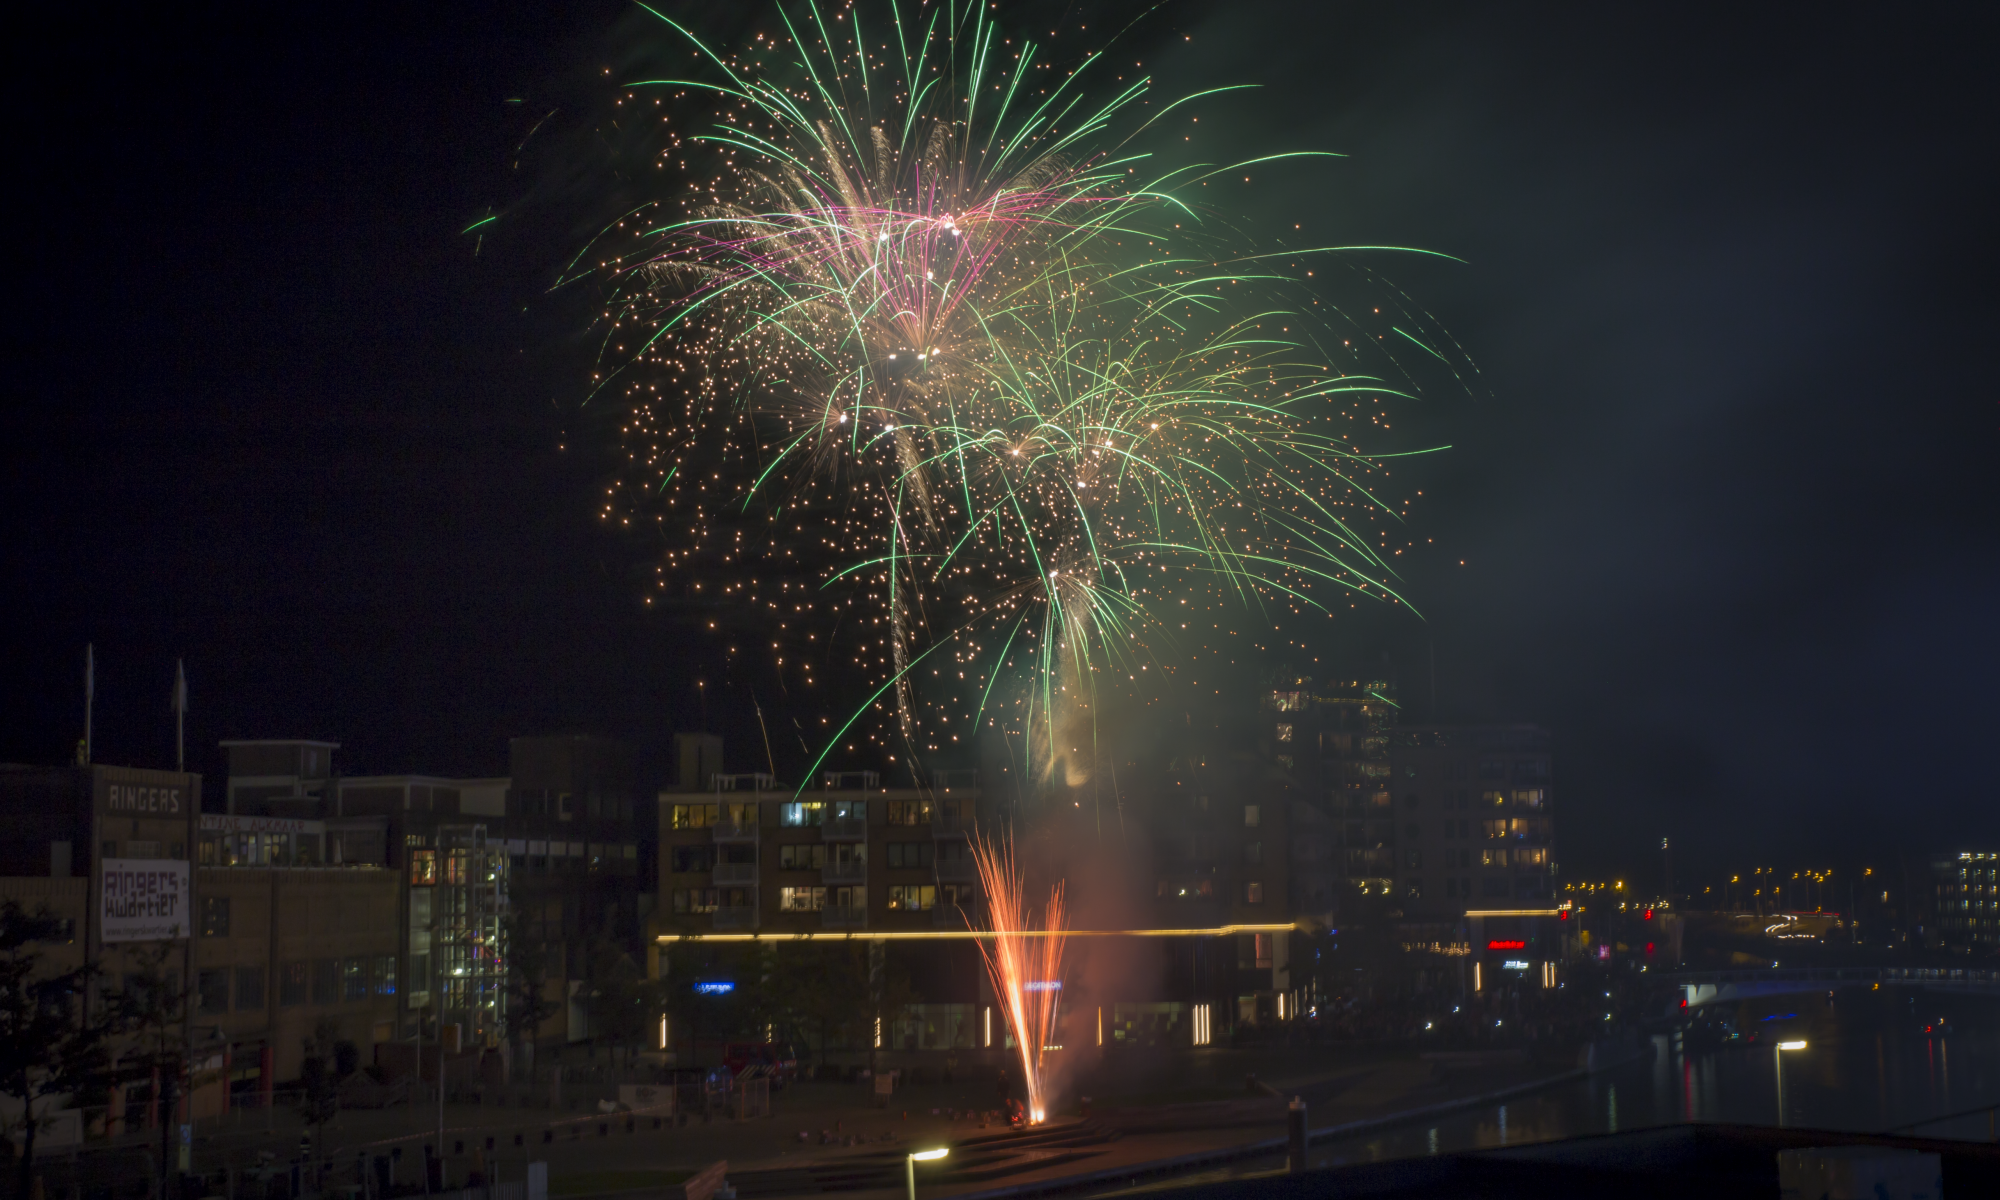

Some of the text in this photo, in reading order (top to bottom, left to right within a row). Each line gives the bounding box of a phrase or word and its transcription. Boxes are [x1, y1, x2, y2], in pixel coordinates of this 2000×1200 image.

[109, 784, 180, 813] RINGERS
[250, 818, 305, 833] ALKMAAR
[104, 863, 179, 897] Ringers
[105, 924, 177, 938] www.ringerskwartier.
